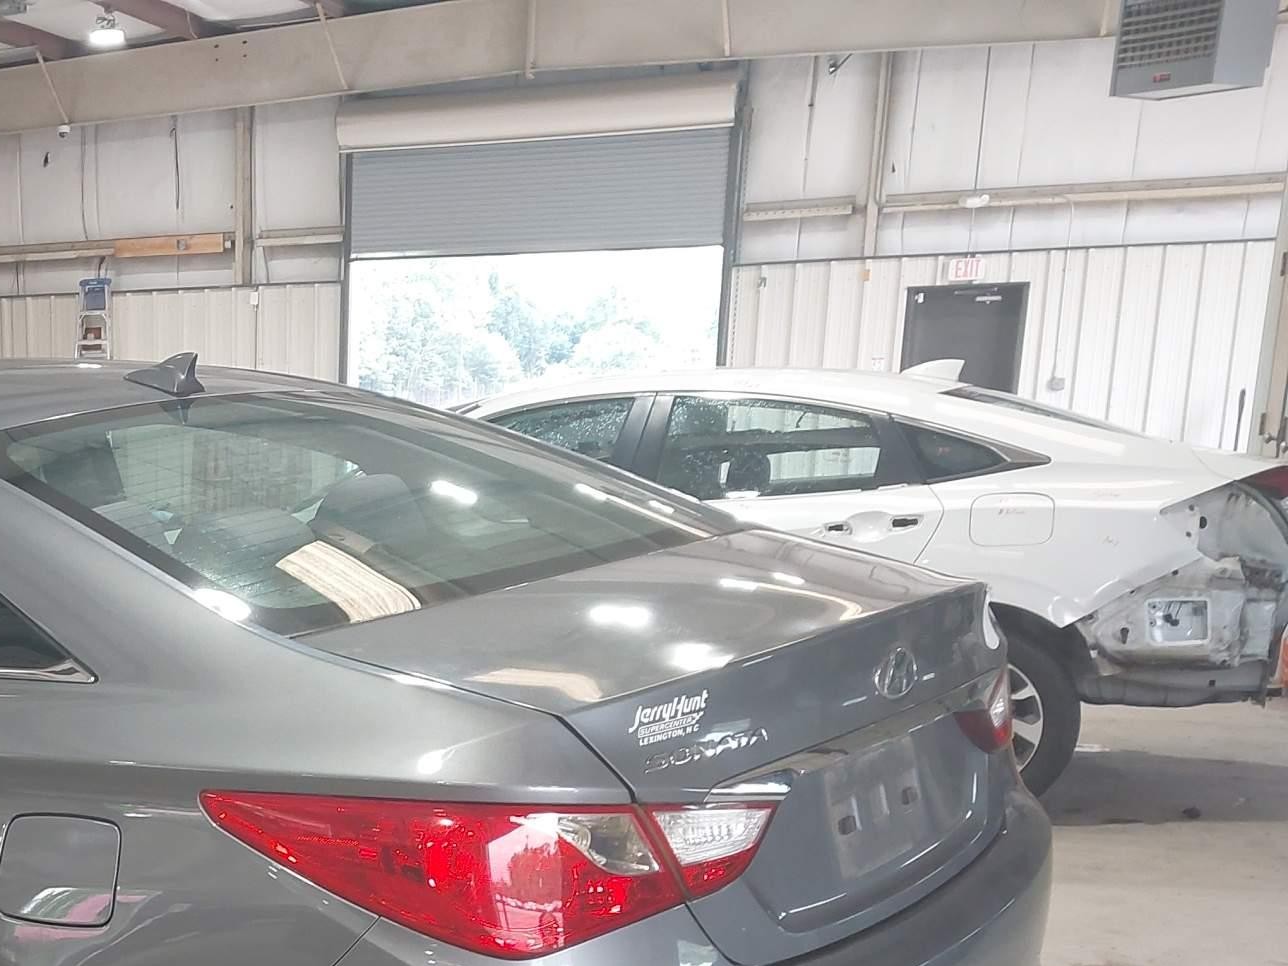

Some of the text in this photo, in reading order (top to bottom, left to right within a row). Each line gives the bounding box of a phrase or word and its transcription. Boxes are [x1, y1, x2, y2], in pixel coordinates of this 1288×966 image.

[954, 259, 981, 278] EXIT
[639, 715, 693, 737] SUPERCENTER
[639, 728, 686, 747] LEXINGTON,
[644, 727, 769, 774] SONATA
